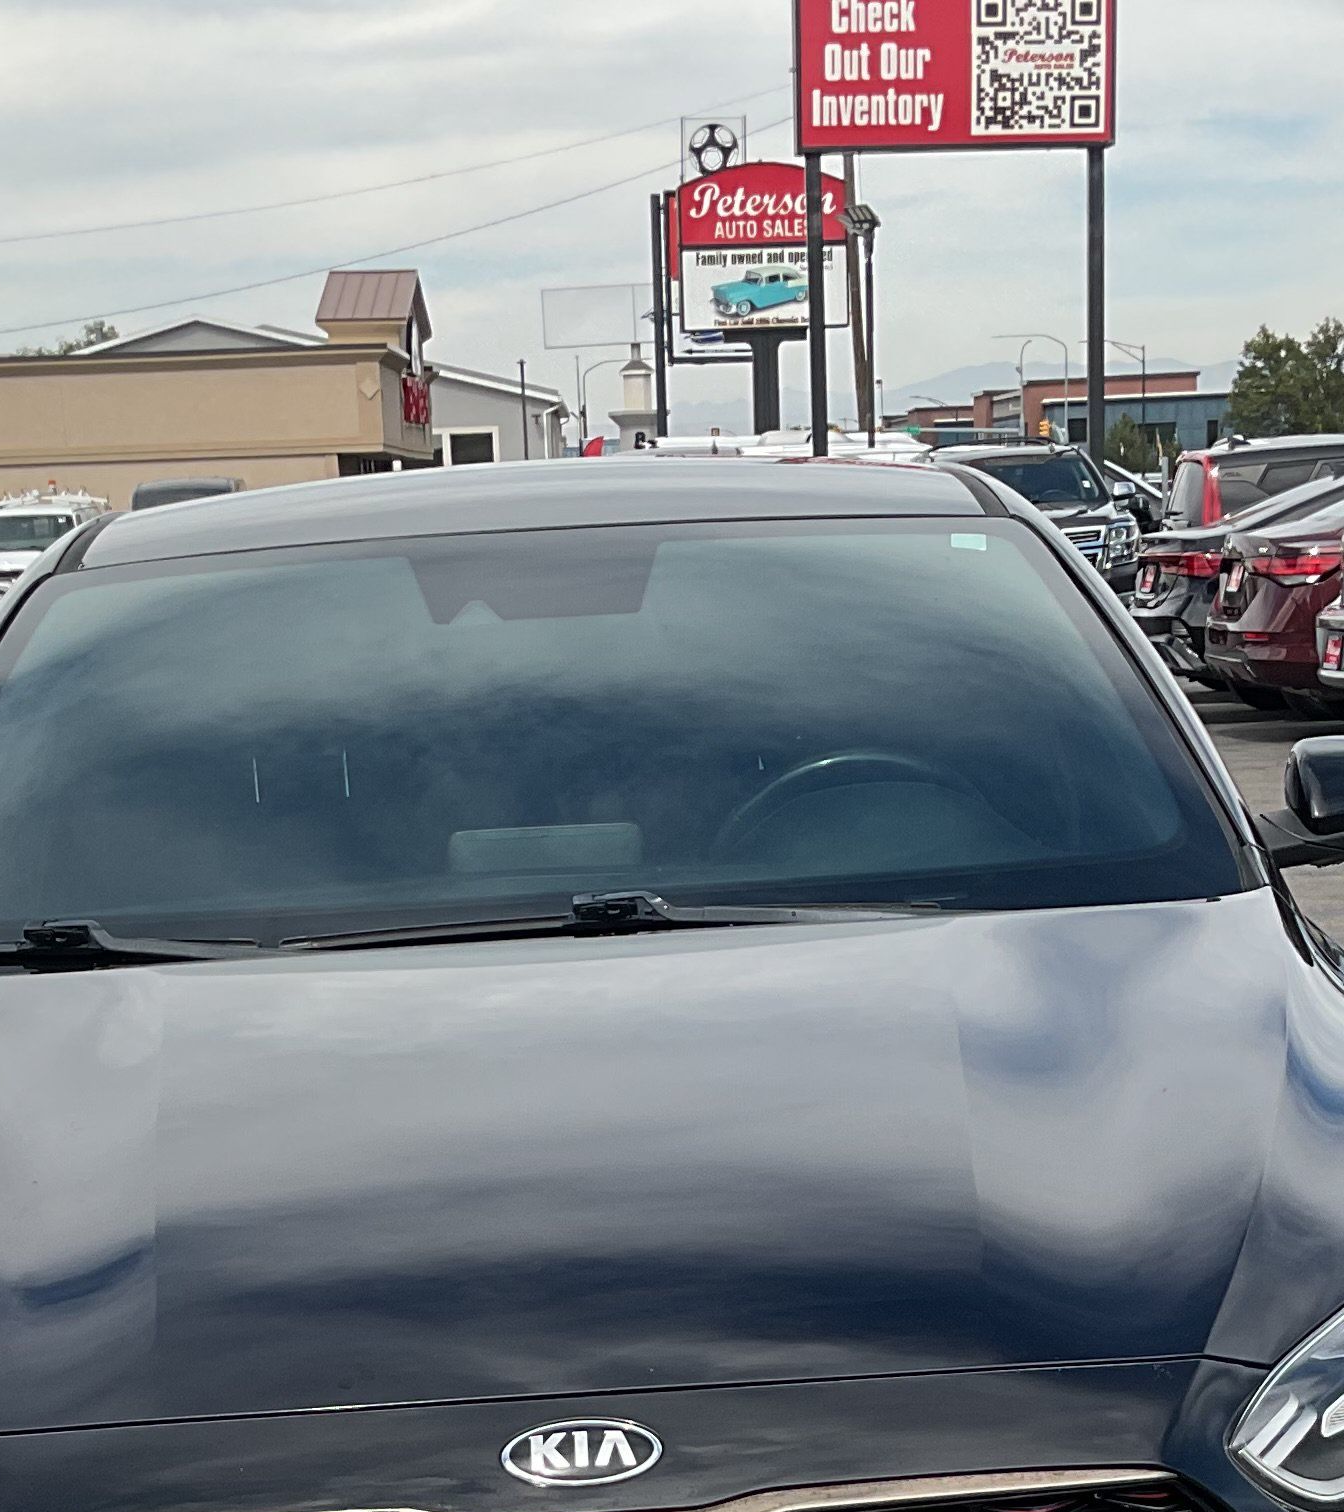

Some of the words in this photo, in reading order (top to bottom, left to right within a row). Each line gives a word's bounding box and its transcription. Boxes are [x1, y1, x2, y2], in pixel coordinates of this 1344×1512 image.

[831, 0, 916, 34] Check
[824, 42, 871, 82] Out
[880, 41, 931, 81] Our
[1002, 48, 1076, 64] Peterson
[812, 87, 944, 132] Inventory
[714, 219, 757, 239] AUTO
[696, 251, 727, 267] Family
[731, 249, 763, 265] owned
[767, 247, 785, 263] and
[529, 1429, 638, 1473] KIA
